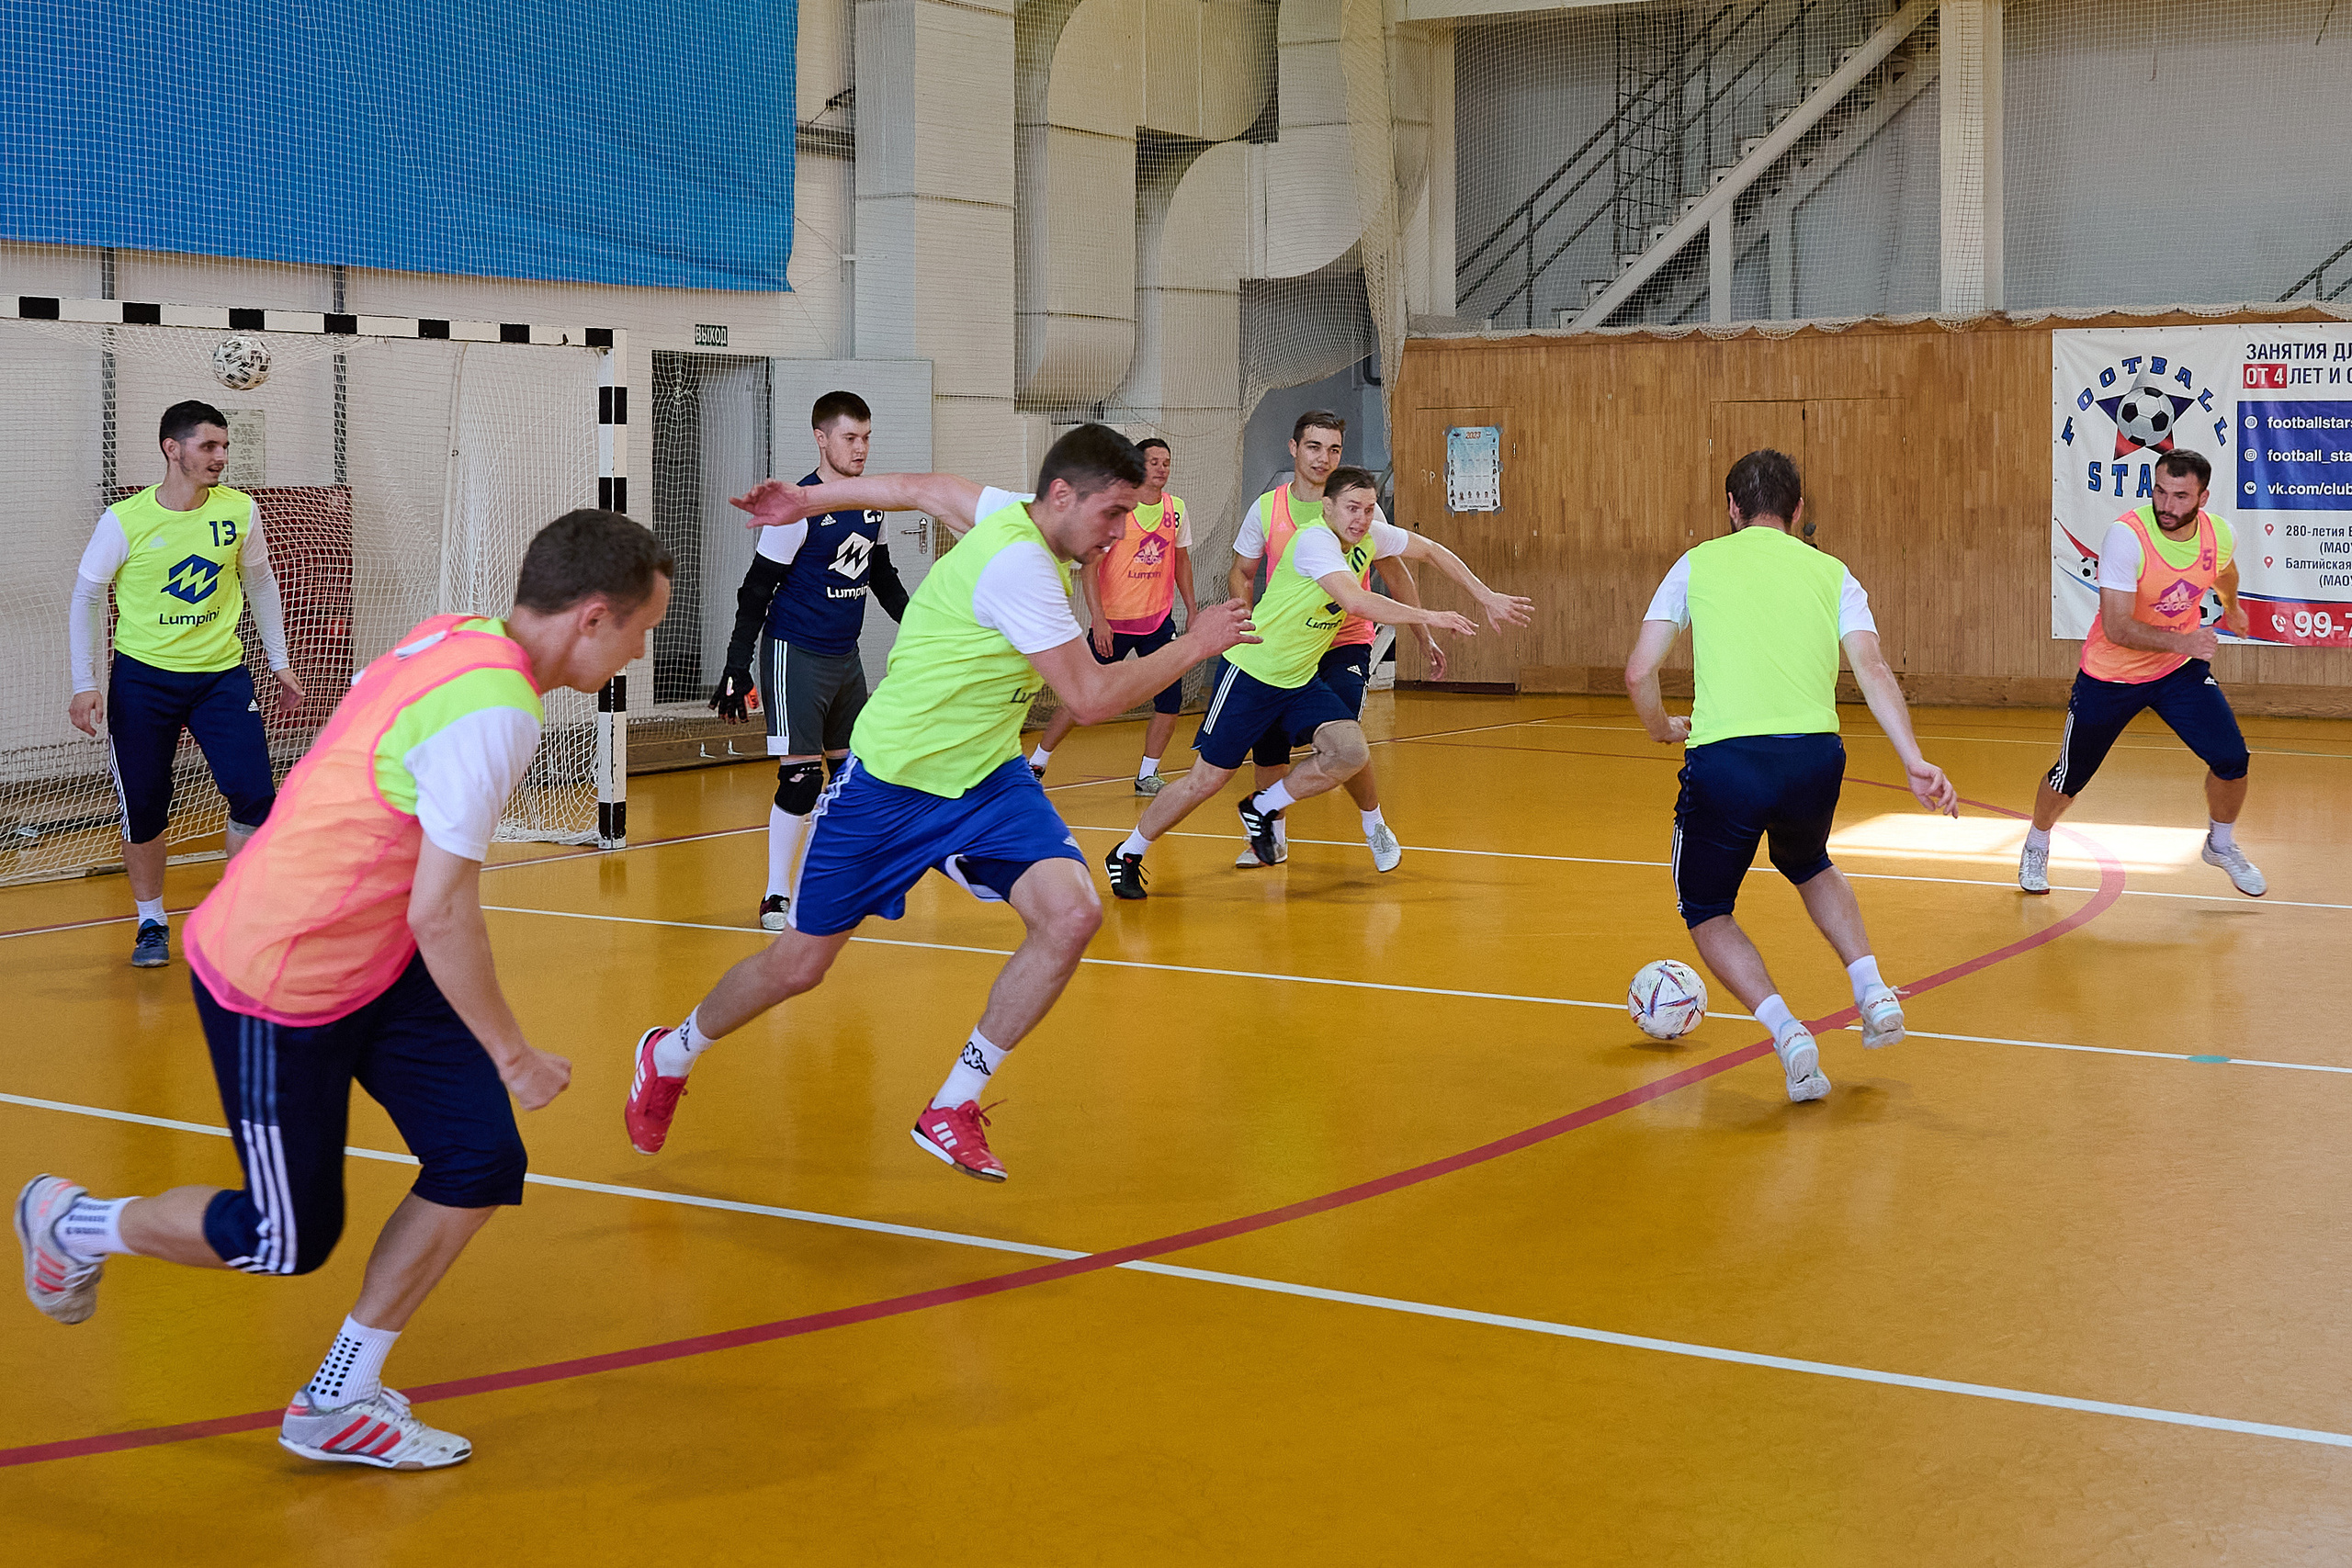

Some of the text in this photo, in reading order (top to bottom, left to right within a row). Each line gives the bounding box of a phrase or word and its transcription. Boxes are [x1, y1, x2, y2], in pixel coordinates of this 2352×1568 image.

[695, 326, 728, 345] ВЫХОД
[2246, 343, 2327, 360] ЗАНЯТИЯ
[2245, 367, 2269, 385] ОТ
[2274, 367, 2284, 385] 4
[2290, 367, 2324, 384] ЛЕТ
[2329, 367, 2340, 384] И
[2061, 355, 2228, 446] FOOTBALL
[2267, 416, 2352, 429] footballstar
[1465, 431, 1481, 439] 2023
[2087, 461, 2154, 497] STA
[2267, 482, 2352, 495] vk.com/club
[1163, 513, 1171, 528] 8
[209, 520, 237, 547] 13
[2286, 525, 2345, 537] 280-летия
[2202, 548, 2213, 571] 5
[2286, 558, 2352, 570] Балтийская
[159, 606, 220, 627] Lumpini
